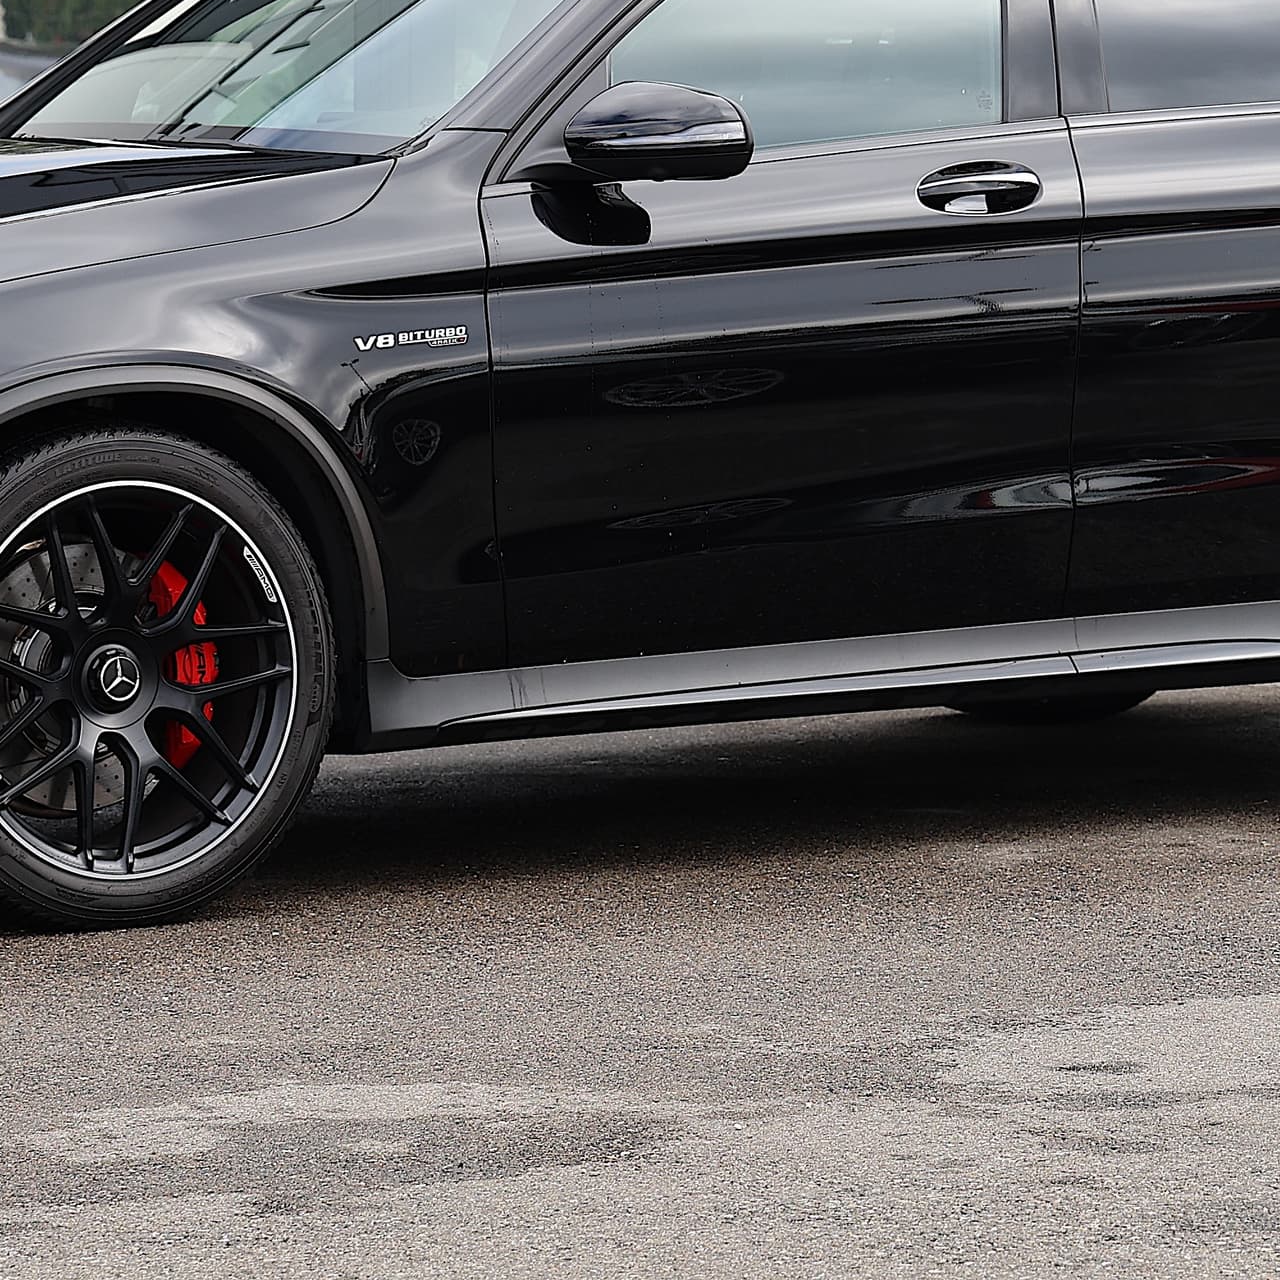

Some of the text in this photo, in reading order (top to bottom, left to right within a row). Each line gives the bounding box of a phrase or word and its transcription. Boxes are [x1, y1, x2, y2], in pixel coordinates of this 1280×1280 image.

[354, 325, 468, 351] V8 BITURBO
[55, 453, 122, 476] LATITUDE
